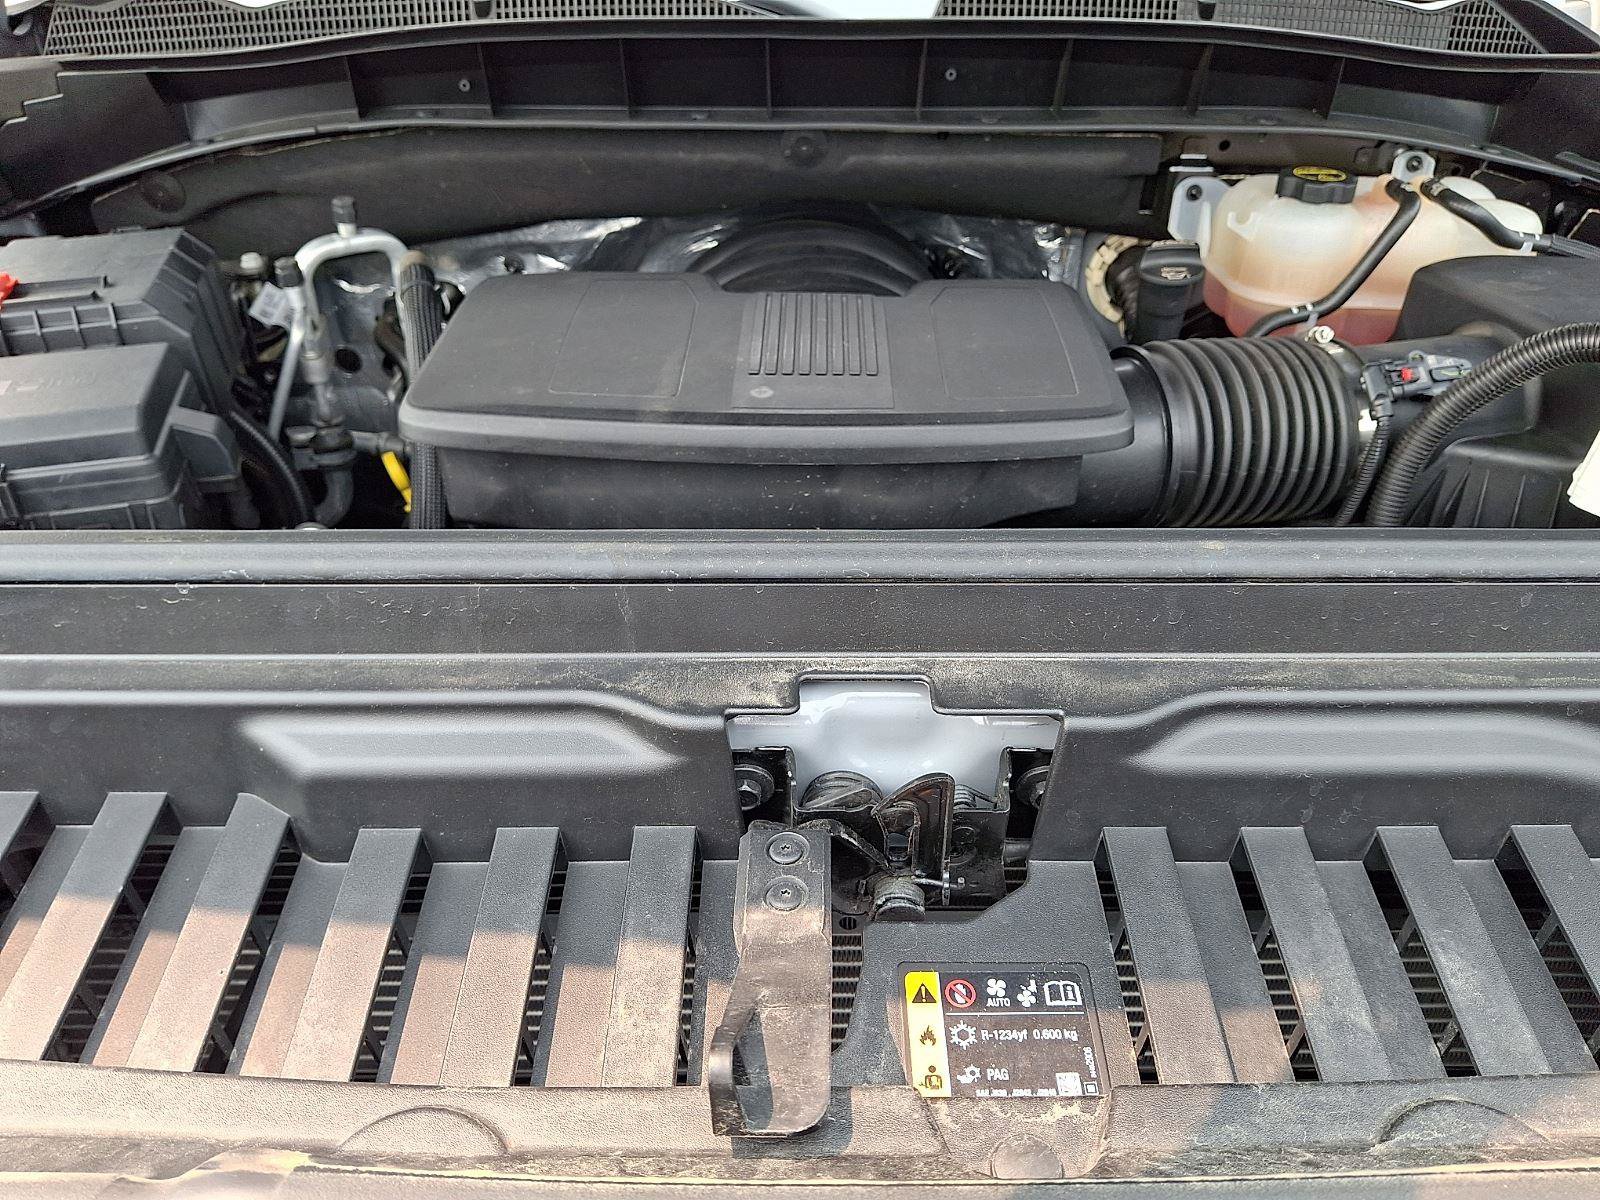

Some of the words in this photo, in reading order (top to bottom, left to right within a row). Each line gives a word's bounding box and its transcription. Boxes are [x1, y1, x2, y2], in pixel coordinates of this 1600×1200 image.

[986, 997, 1011, 1007] AUTO
[981, 1029, 1028, 1042] R-1234yf
[1063, 1028, 1079, 1042] kg
[987, 1068, 1009, 1081] PAG
